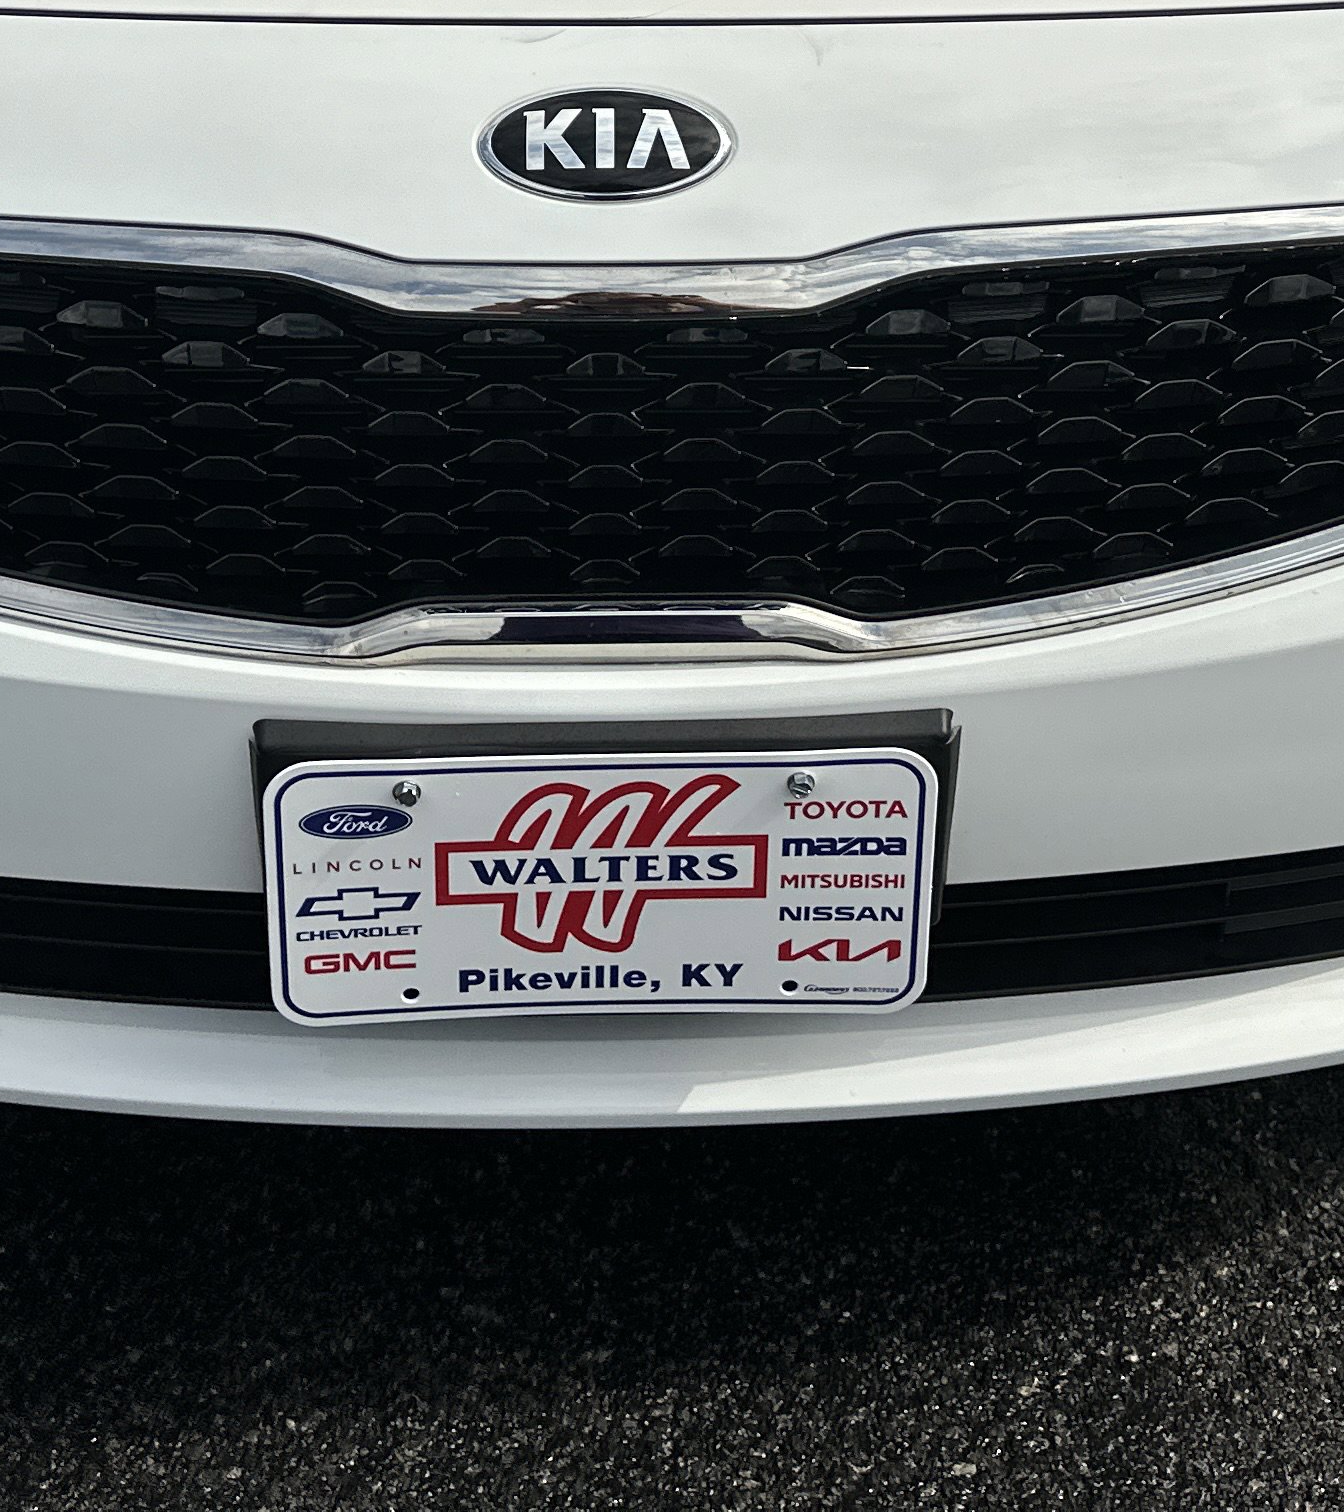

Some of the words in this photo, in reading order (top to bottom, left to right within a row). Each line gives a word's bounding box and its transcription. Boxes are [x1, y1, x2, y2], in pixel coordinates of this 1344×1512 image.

[523, 108, 691, 171] KIA
[783, 800, 908, 820] TOYOTA
[323, 810, 389, 834] Ford
[292, 857, 422, 875] LINCOLN
[469, 853, 739, 886] WALTERS
[780, 874, 905, 889] MITSUBISHI
[778, 906, 904, 922] NISSAN
[296, 925, 422, 942] CHEVROLET
[304, 949, 417, 975] GMC
[458, 965, 661, 993] Pikeville,
[681, 963, 744, 988] KY
